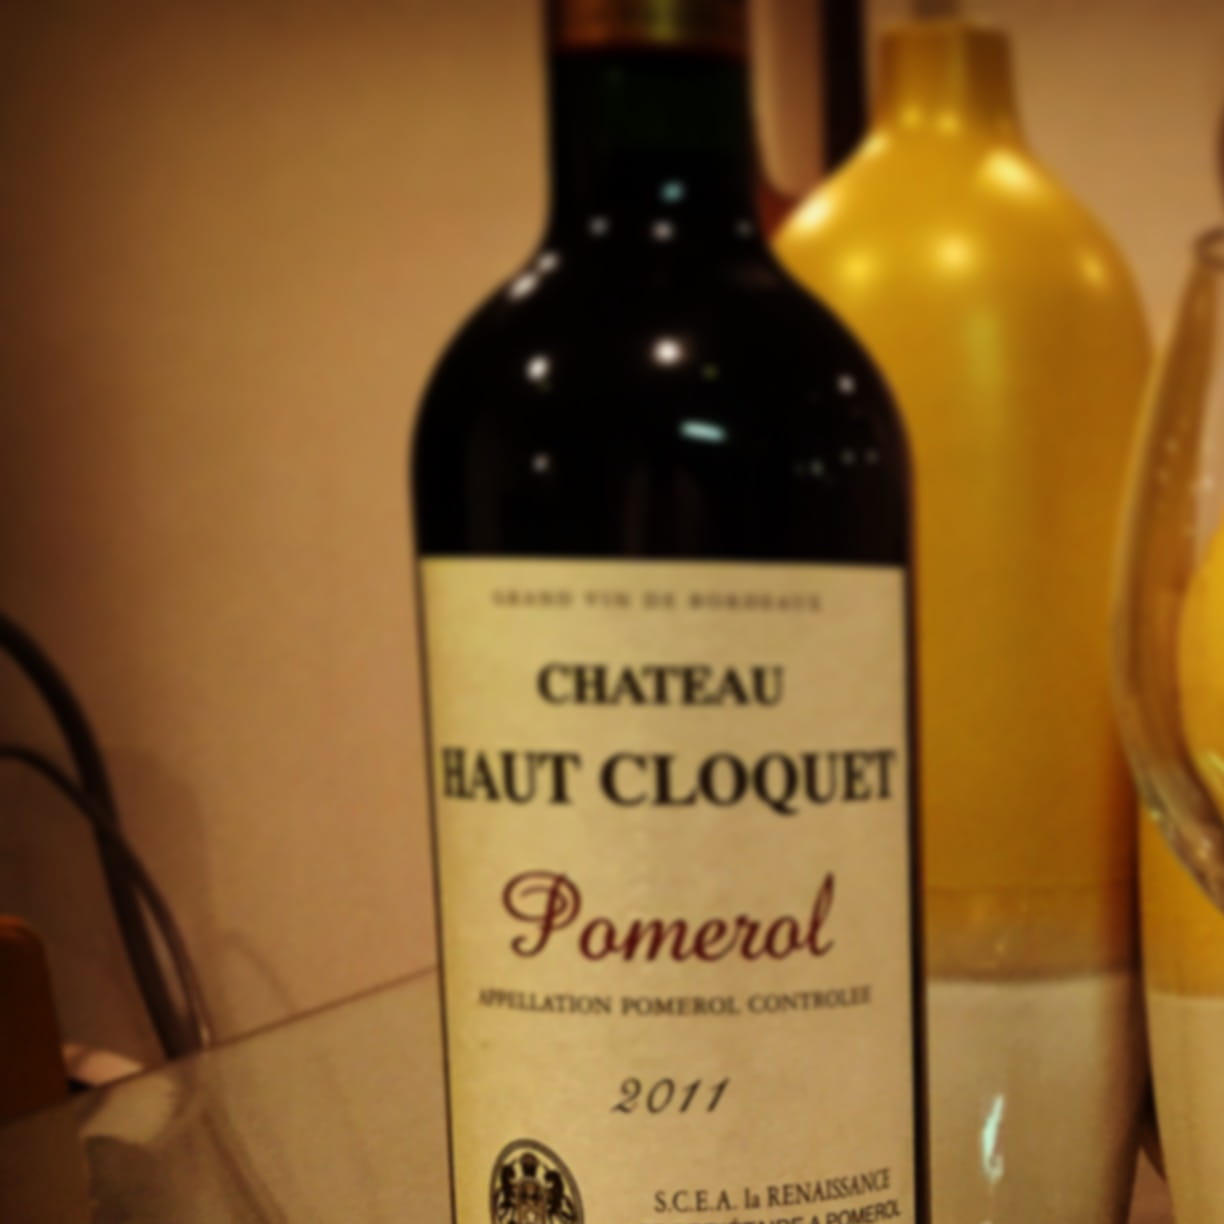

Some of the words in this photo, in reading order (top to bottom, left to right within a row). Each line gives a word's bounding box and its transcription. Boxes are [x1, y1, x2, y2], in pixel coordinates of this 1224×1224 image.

[536, 661, 786, 706] CHATEAU
[441, 745, 582, 807] HAUT
[600, 747, 897, 817] CLOQUET
[502, 869, 836, 963] Pomerol
[478, 986, 612, 1017] APPELLATION
[621, 993, 740, 1017] POMEROL
[610, 1074, 731, 1115] 2011
[653, 1188, 738, 1214] S.C.E.A.
[767, 1166, 893, 1208] RENAISSANCE
